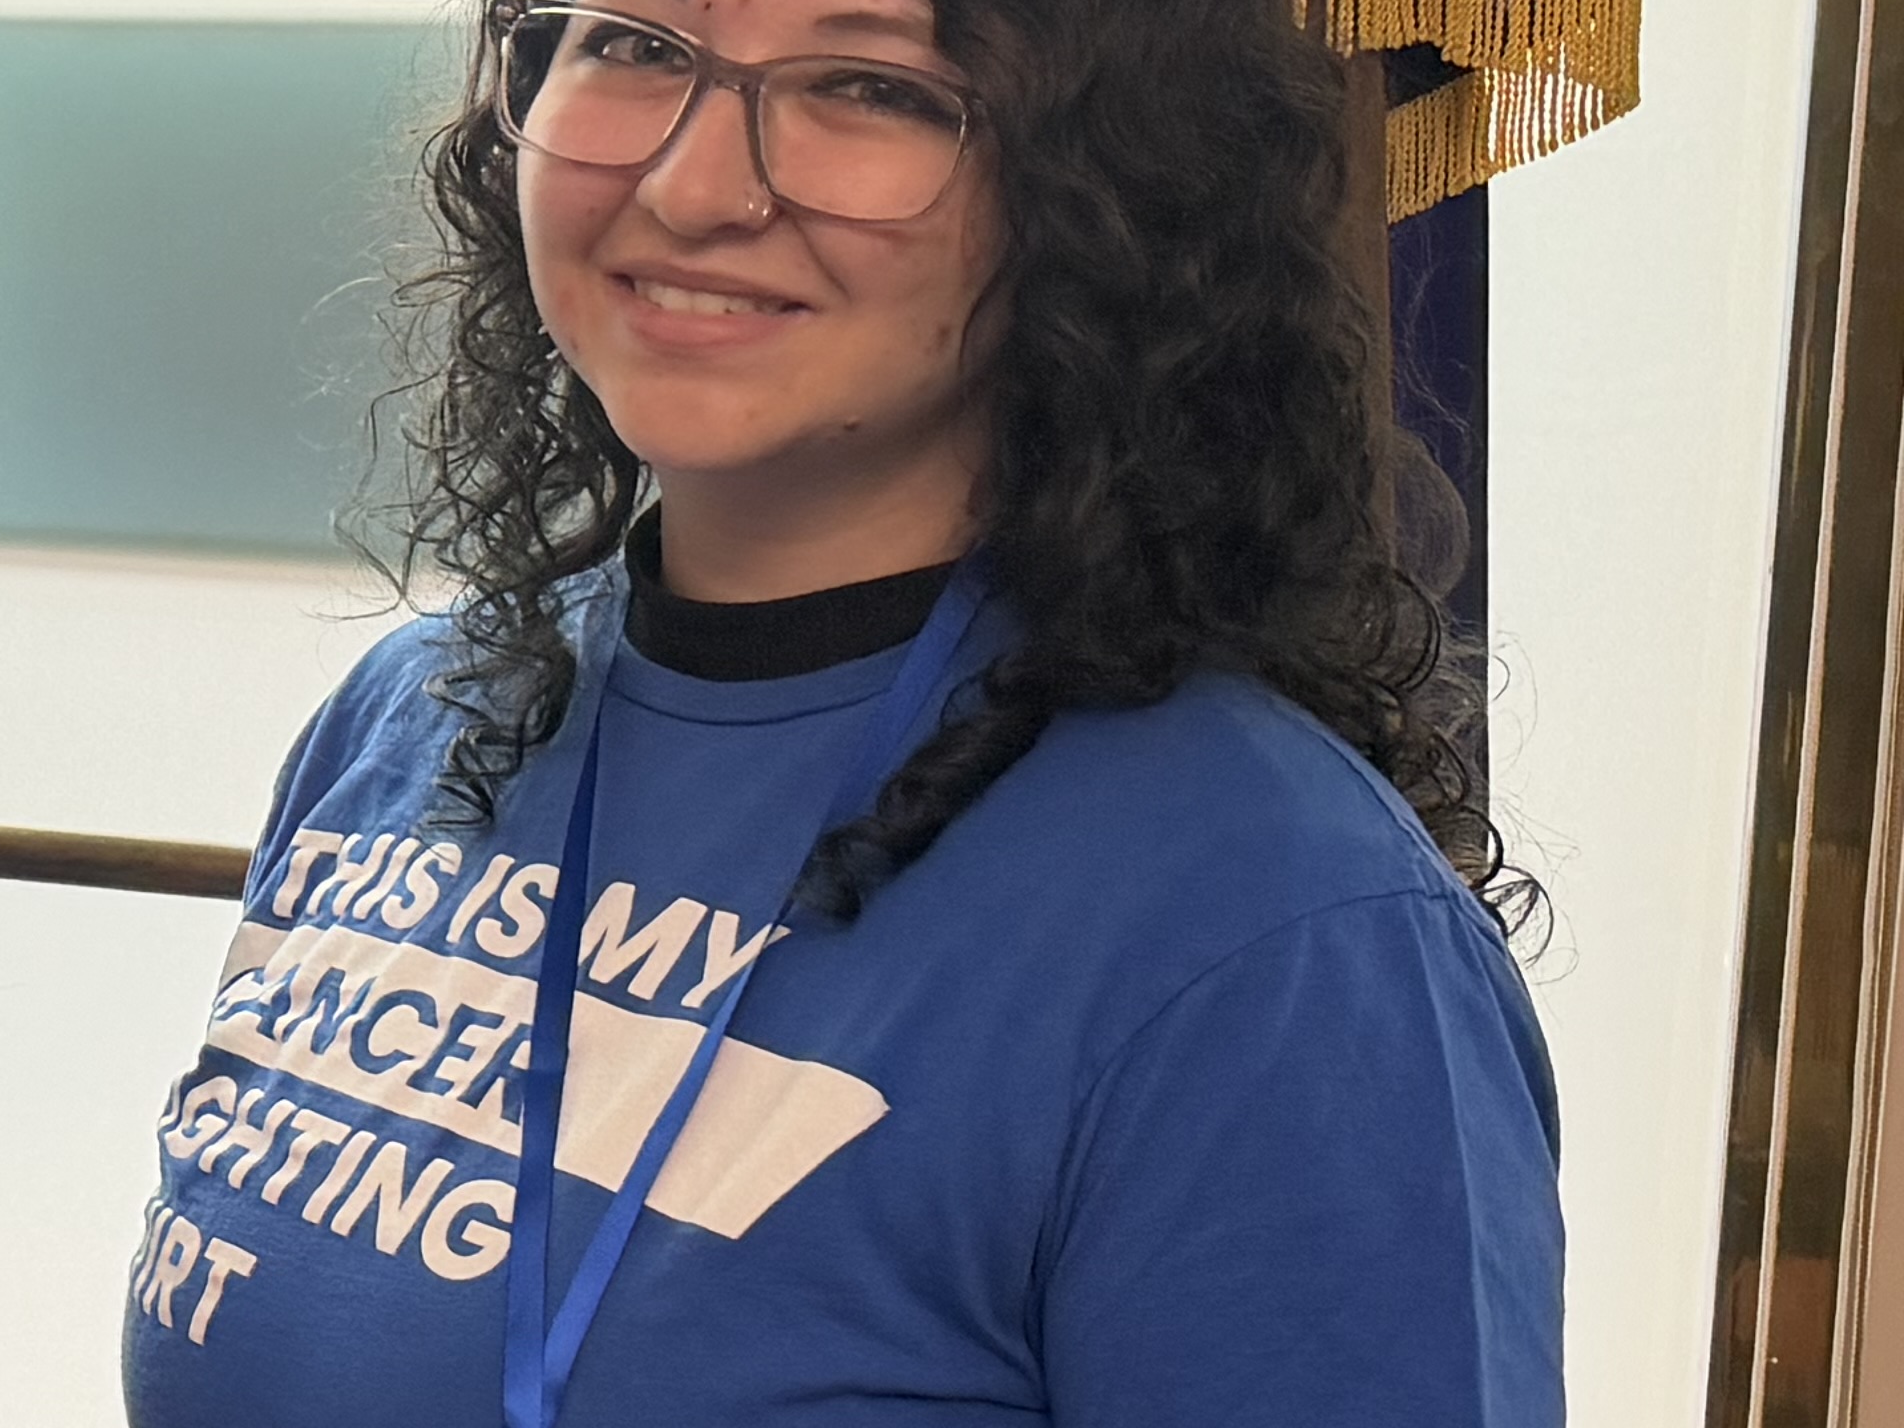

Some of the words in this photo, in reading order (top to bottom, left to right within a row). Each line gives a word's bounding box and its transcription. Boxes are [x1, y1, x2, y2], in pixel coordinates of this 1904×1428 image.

[271, 827, 463, 930] THIS
[446, 853, 560, 959] IS
[577, 881, 792, 1009] MY
[213, 963, 534, 1128] ANCER
